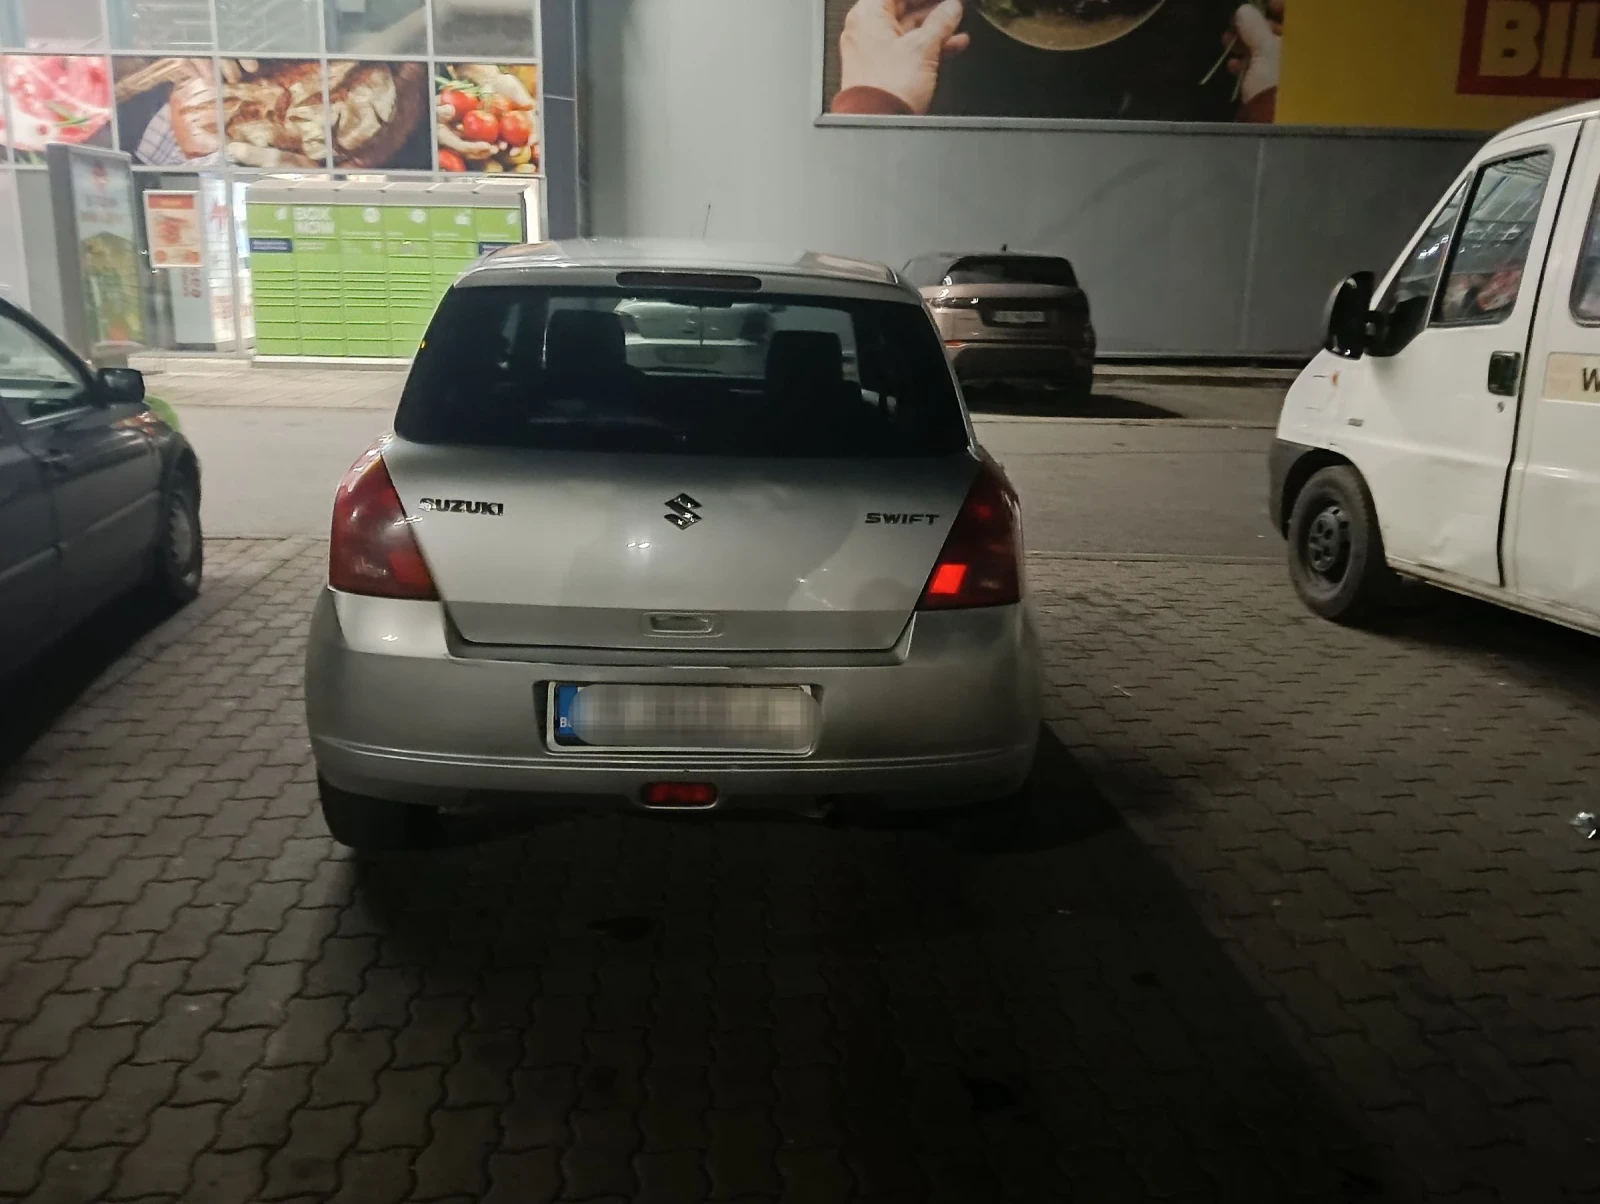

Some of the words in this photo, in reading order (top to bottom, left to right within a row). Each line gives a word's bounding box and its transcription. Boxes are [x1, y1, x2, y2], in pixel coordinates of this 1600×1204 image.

[294, 207, 334, 220] BOX
[419, 498, 504, 516] SUZUKI
[865, 513, 940, 525] SWIFT
